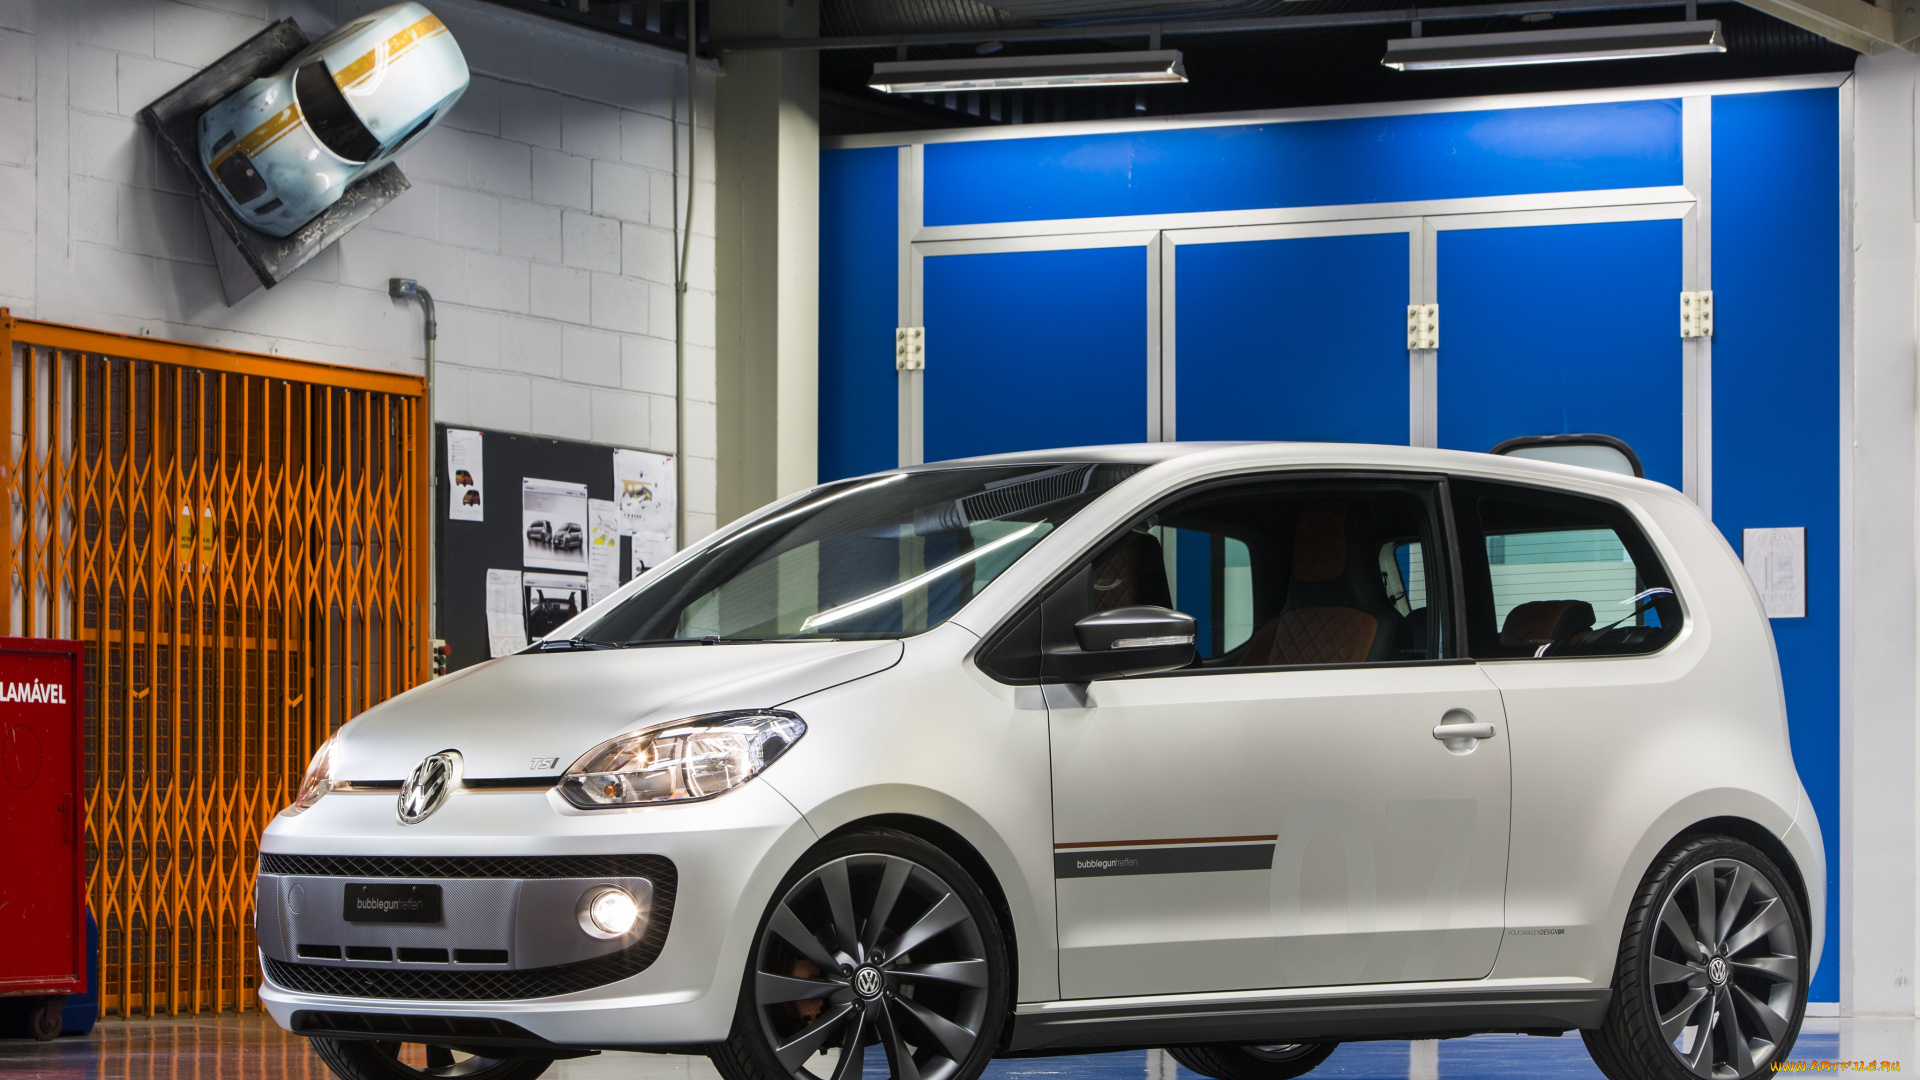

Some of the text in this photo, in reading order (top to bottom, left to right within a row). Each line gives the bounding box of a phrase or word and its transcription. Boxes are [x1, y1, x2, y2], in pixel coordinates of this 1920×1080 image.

[530, 757, 560, 770] TSI
[1076, 857, 1138, 870] bubbleguntreffen
[356, 898, 424, 912] bubbleguntreffen
